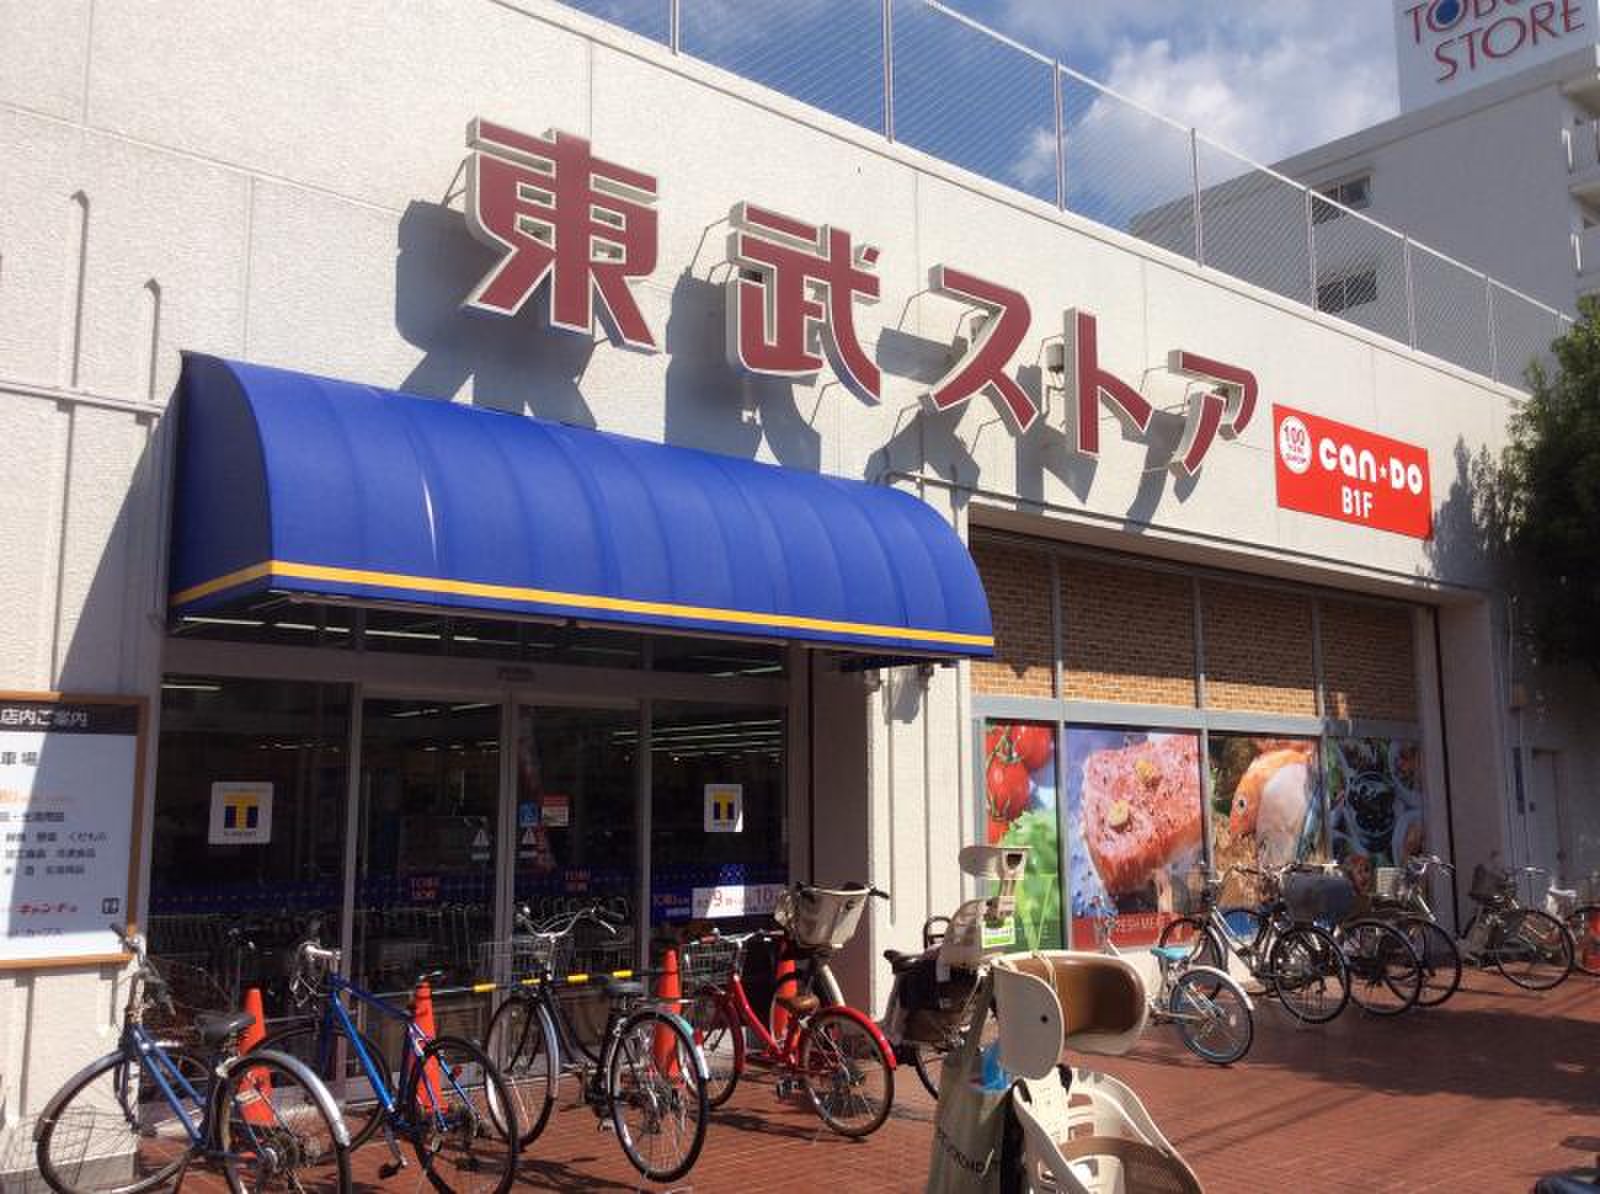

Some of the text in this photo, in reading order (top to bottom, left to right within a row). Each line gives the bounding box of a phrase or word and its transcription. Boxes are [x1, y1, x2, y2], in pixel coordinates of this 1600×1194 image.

[1404, 0, 1517, 44] TOB
[1435, 1, 1584, 83] STORE
[465, 116, 1258, 475] 東武ストア
